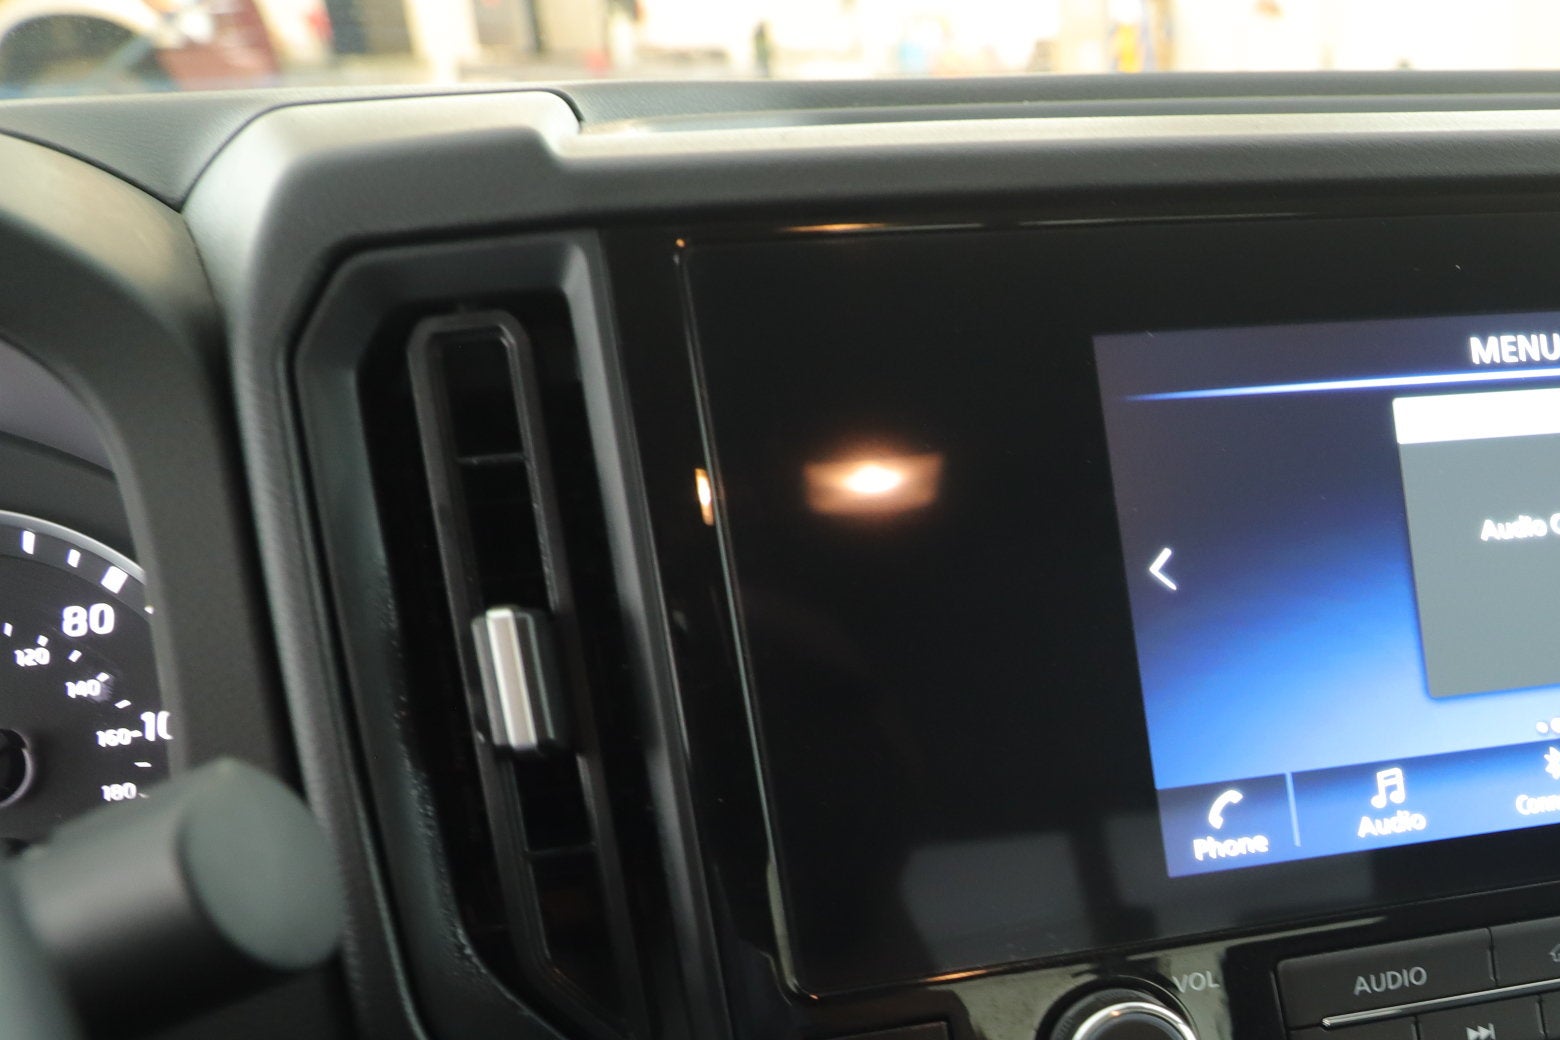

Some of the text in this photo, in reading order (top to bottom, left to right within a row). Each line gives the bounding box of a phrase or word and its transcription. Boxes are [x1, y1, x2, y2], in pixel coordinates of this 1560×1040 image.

[1480, 514, 1548, 542] Audio
[62, 603, 115, 638] 80
[14, 647, 50, 668] 120
[65, 679, 102, 699] 140
[96, 728, 132, 748] 160
[101, 782, 137, 802] 180
[1358, 809, 1428, 839] Audio
[1193, 832, 1269, 861] Phone
[1171, 970, 1222, 994] VOL
[1353, 966, 1428, 996] AUDIO
